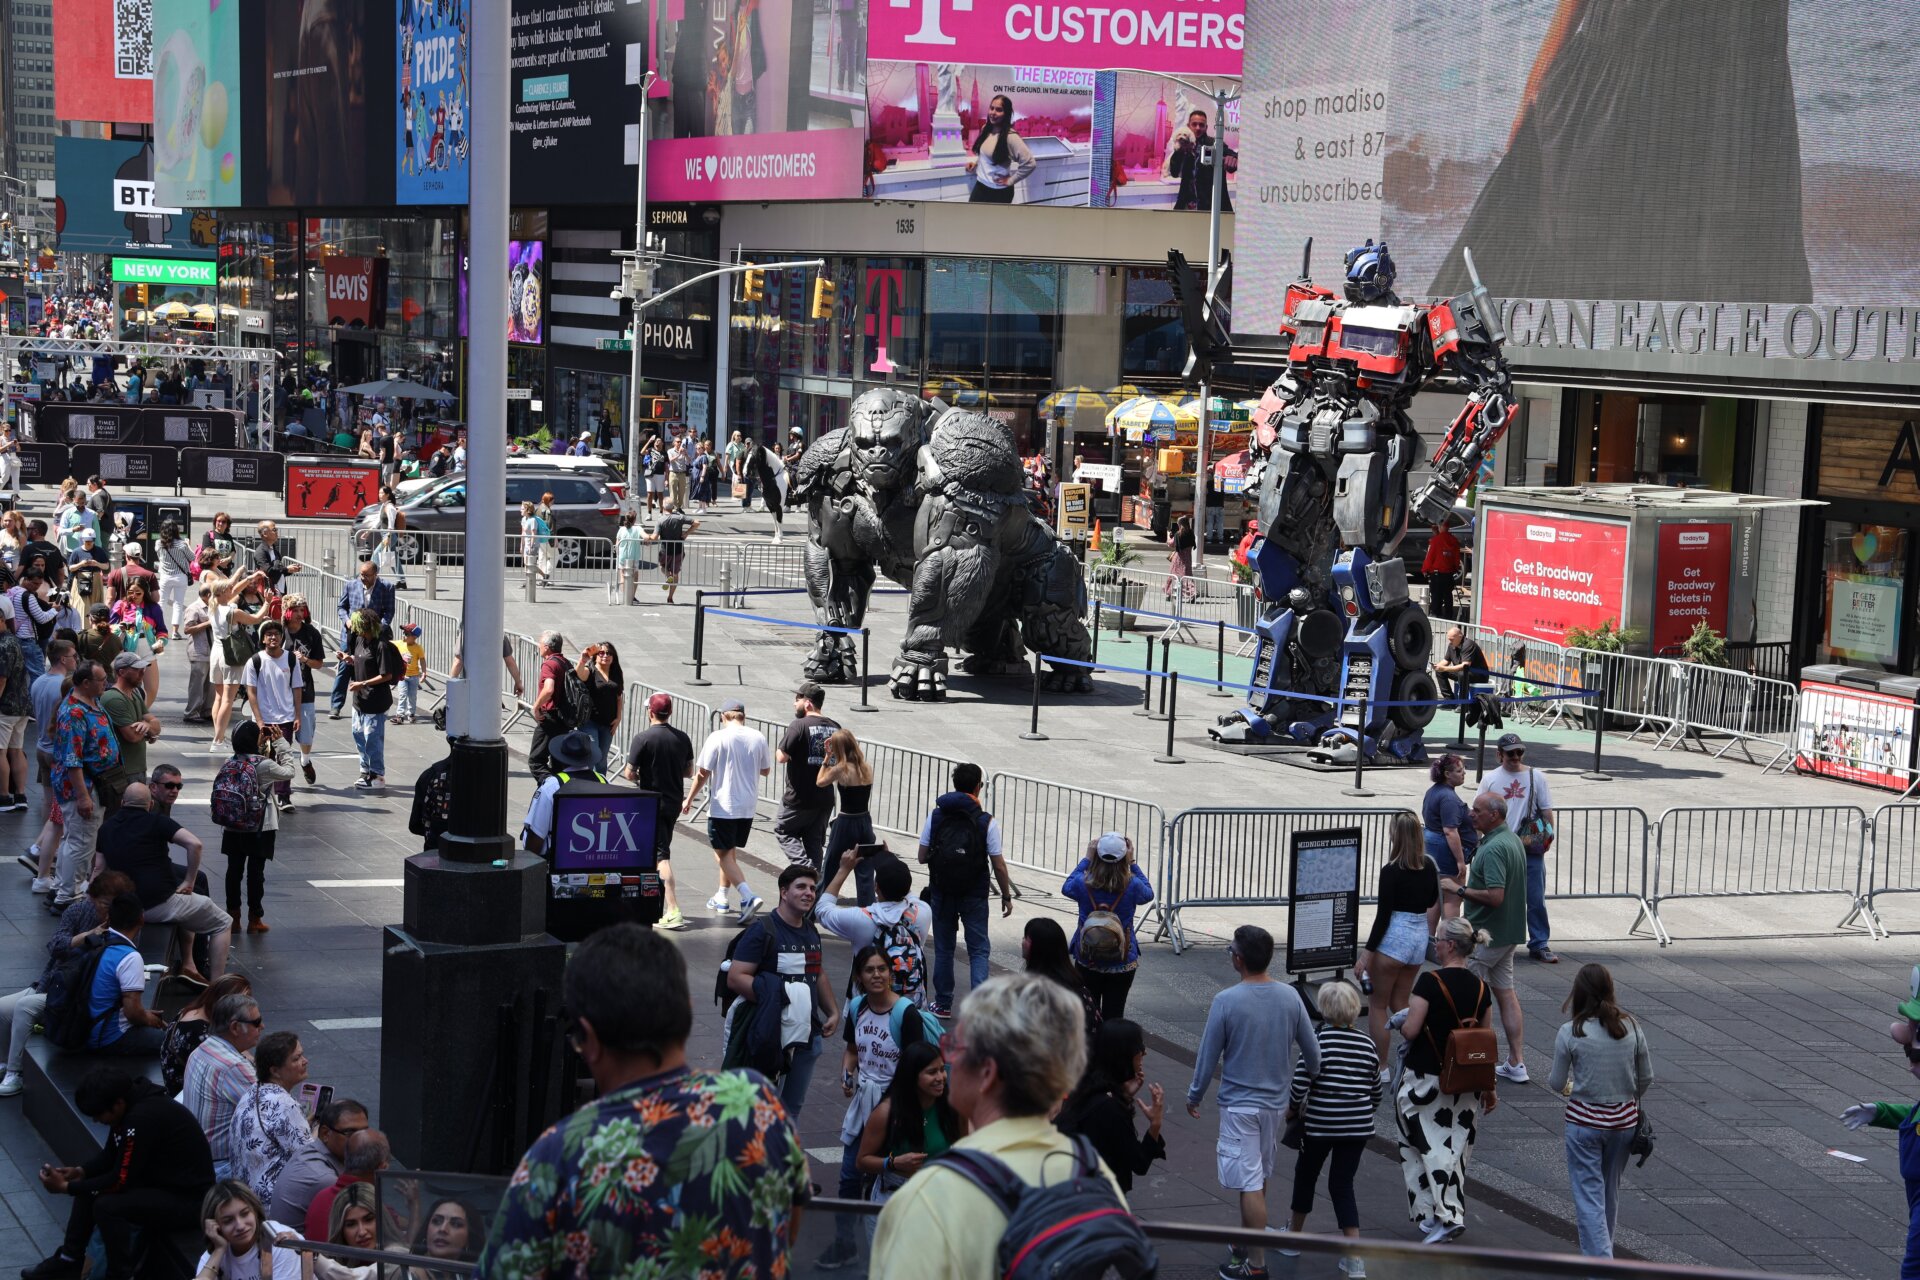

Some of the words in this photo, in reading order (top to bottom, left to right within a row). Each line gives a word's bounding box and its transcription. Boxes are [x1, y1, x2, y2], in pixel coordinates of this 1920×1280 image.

[522, 14, 531, 26] me
[531, 9, 542, 24] that
[546, 10, 556, 22] can
[557, 5, 573, 20] dance
[574, 1, 590, 17] while
[518, 32, 530, 49] hips
[530, 29, 545, 45] while
[549, 26, 565, 43] shake
[566, 28, 573, 43] up
[574, 24, 583, 39] the
[584, 20, 603, 37] world.
[1005, 3, 1245, 50] CUSTOMERS
[415, 36, 456, 88] PRIDE
[538, 54, 547, 67] are
[547, 50, 560, 67] part
[560, 47, 567, 63] of
[567, 46, 577, 62] the
[1014, 67, 1041, 82] THE
[993, 84, 1003, 92] ON
[1004, 85, 1015, 93] THE
[515, 103, 539, 115] Contributing
[539, 101, 552, 112] Writer
[1264, 95, 1307, 122] shop
[1314, 88, 1385, 115] madiso
[1294, 136, 1306, 160] &
[1314, 133, 1355, 159] east
[1362, 131, 1385, 156] 87
[685, 157, 702, 181] WE
[720, 156, 743, 179] OUR
[745, 152, 816, 178] CUSTOMERS
[120, 186, 155, 206] BT
[652, 210, 687, 224] SEPHORA
[896, 219, 915, 234] 1535
[124, 263, 163, 277] NEW
[167, 265, 211, 279] YORK
[1610, 300, 1768, 358] EAGLE
[604, 341, 611, 349] W
[614, 341, 623, 349] 46
[12, 386, 28, 394] TSQ
[1221, 411, 1227, 420] W
[1231, 411, 1240, 420] 46
[1742, 526, 1751, 577] Newsstand
[1513, 558, 1534, 576] Get
[1536, 562, 1594, 585] Broadway
[1683, 567, 1701, 577] Get
[1501, 576, 1538, 597] tickets
[1540, 580, 1551, 598] in
[1553, 584, 1603, 607] seconds.
[1668, 580, 1715, 592] Broadway
[1669, 593, 1701, 603] tickets
[1703, 592, 1712, 602] in
[1852, 599, 1875, 609] BETTER
[1668, 605, 1711, 616] seconds.
[1298, 840, 1330, 849] MIDNIGHT
[1330, 838, 1358, 847] MOMENT
[863, 1025, 878, 1036] WAS
[878, 1029, 889, 1041] IN
